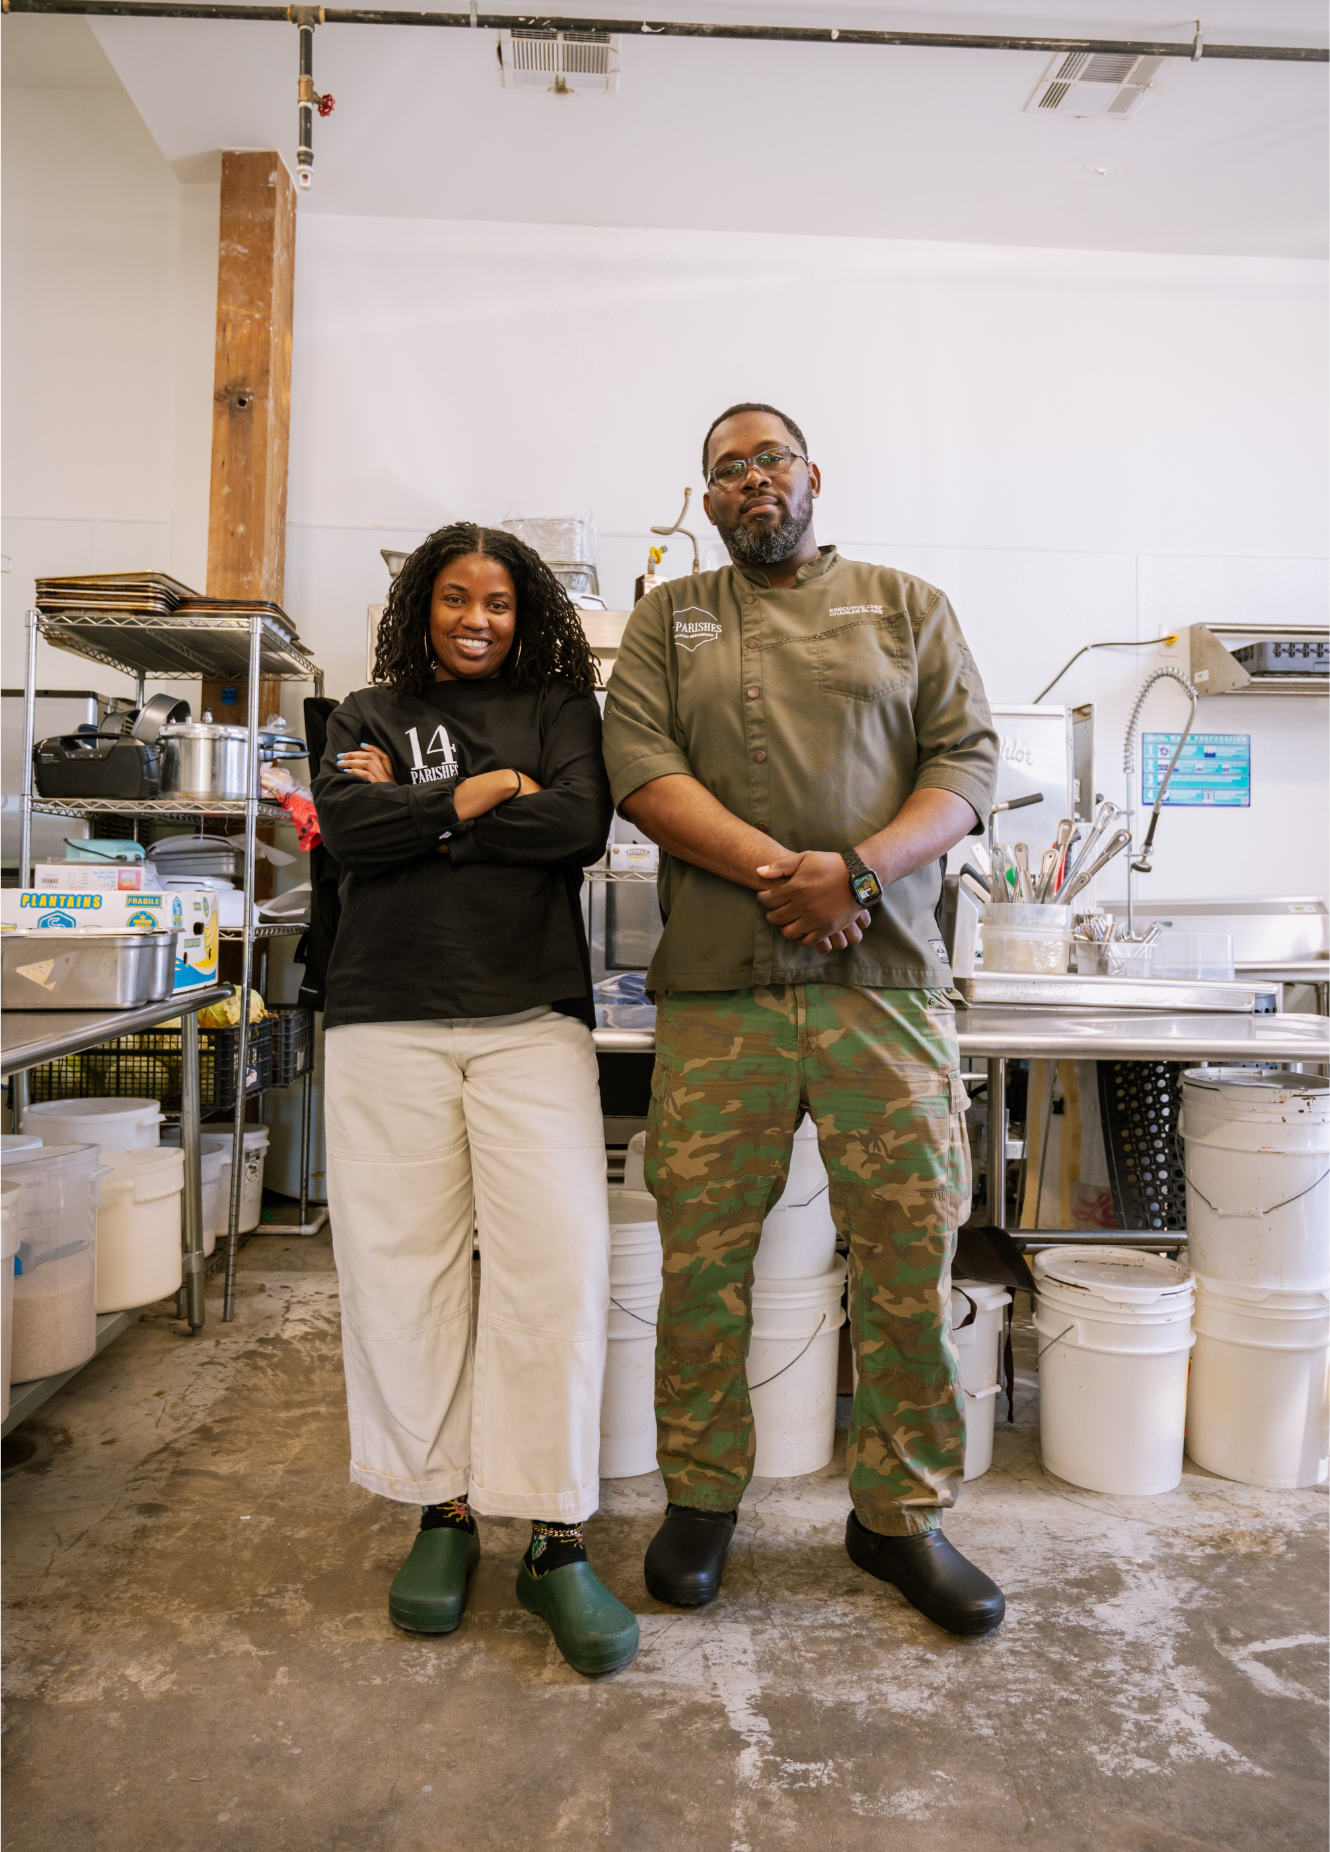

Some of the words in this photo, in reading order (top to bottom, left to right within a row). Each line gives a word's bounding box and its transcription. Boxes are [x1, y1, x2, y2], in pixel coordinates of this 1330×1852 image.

[675, 622, 722, 633] PARISHES
[405, 724, 458, 771] 14
[1149, 745, 1153, 754] 1
[1147, 760, 1153, 769] 2
[410, 764, 458, 785] PARISHES
[1147, 775, 1153, 784] 3
[1147, 790, 1154, 799] 4
[21, 894, 101, 909] PLANTAINS
